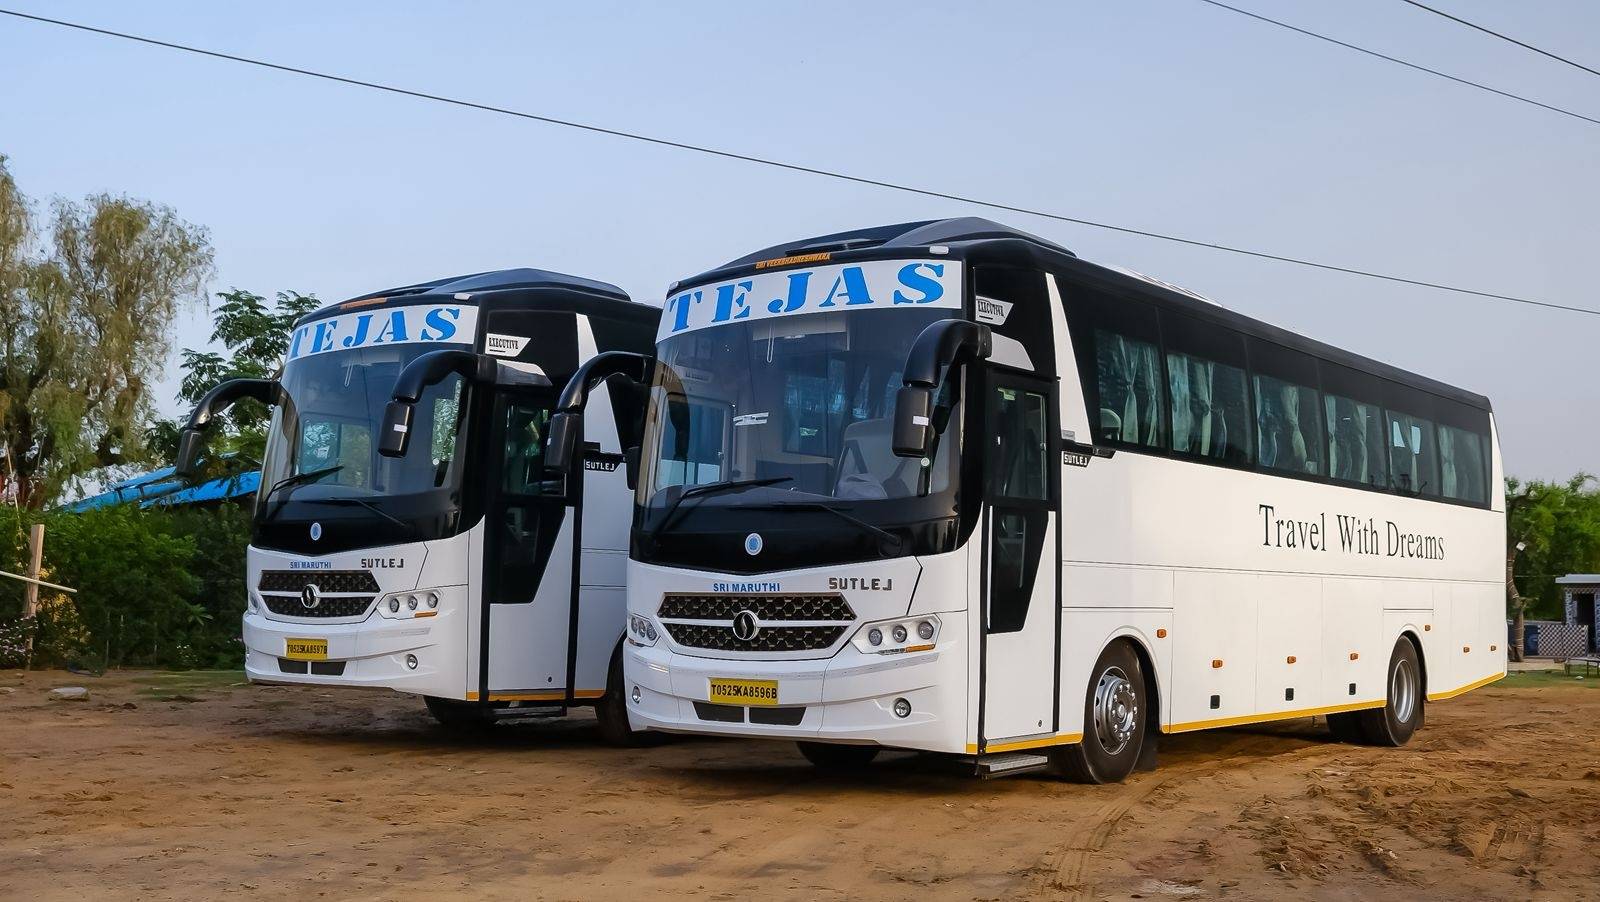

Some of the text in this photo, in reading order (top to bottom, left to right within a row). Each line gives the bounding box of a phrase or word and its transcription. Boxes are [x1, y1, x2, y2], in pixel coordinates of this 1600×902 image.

[669, 262, 945, 333] TEJAS
[289, 308, 460, 359] TEJAS
[489, 337, 519, 350] EXECUTIVE
[585, 461, 615, 470] SUTLEJ
[1064, 454, 1088, 466] SUTLEJ
[1258, 504, 1445, 561] Travel With Dreams
[290, 561, 332, 569] SRI MARUTHI
[361, 558, 404, 568] SUTLEJ
[713, 582, 780, 592] SRI MARUTHI
[829, 577, 893, 591] SUTLEJ
